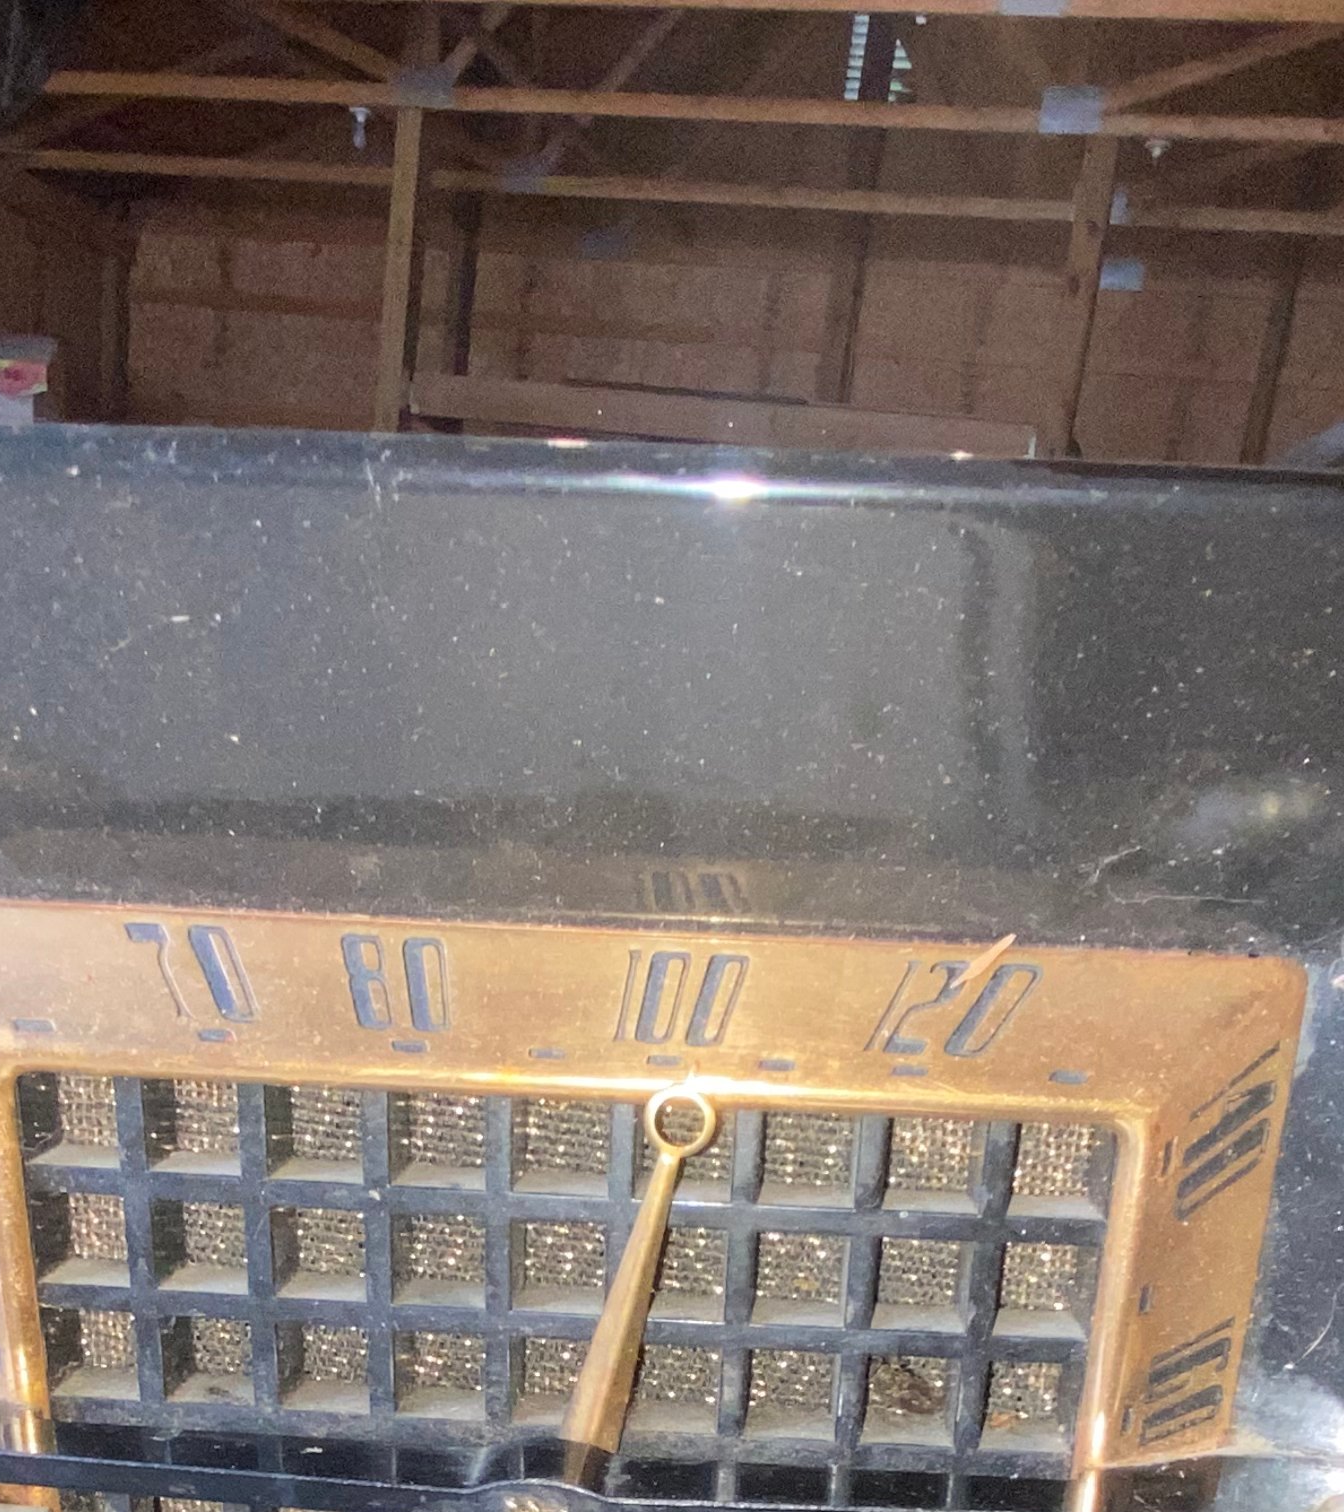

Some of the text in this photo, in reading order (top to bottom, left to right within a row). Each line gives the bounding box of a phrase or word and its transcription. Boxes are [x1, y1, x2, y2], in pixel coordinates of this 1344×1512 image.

[125, 922, 1043, 1057] 70 80 100 120
